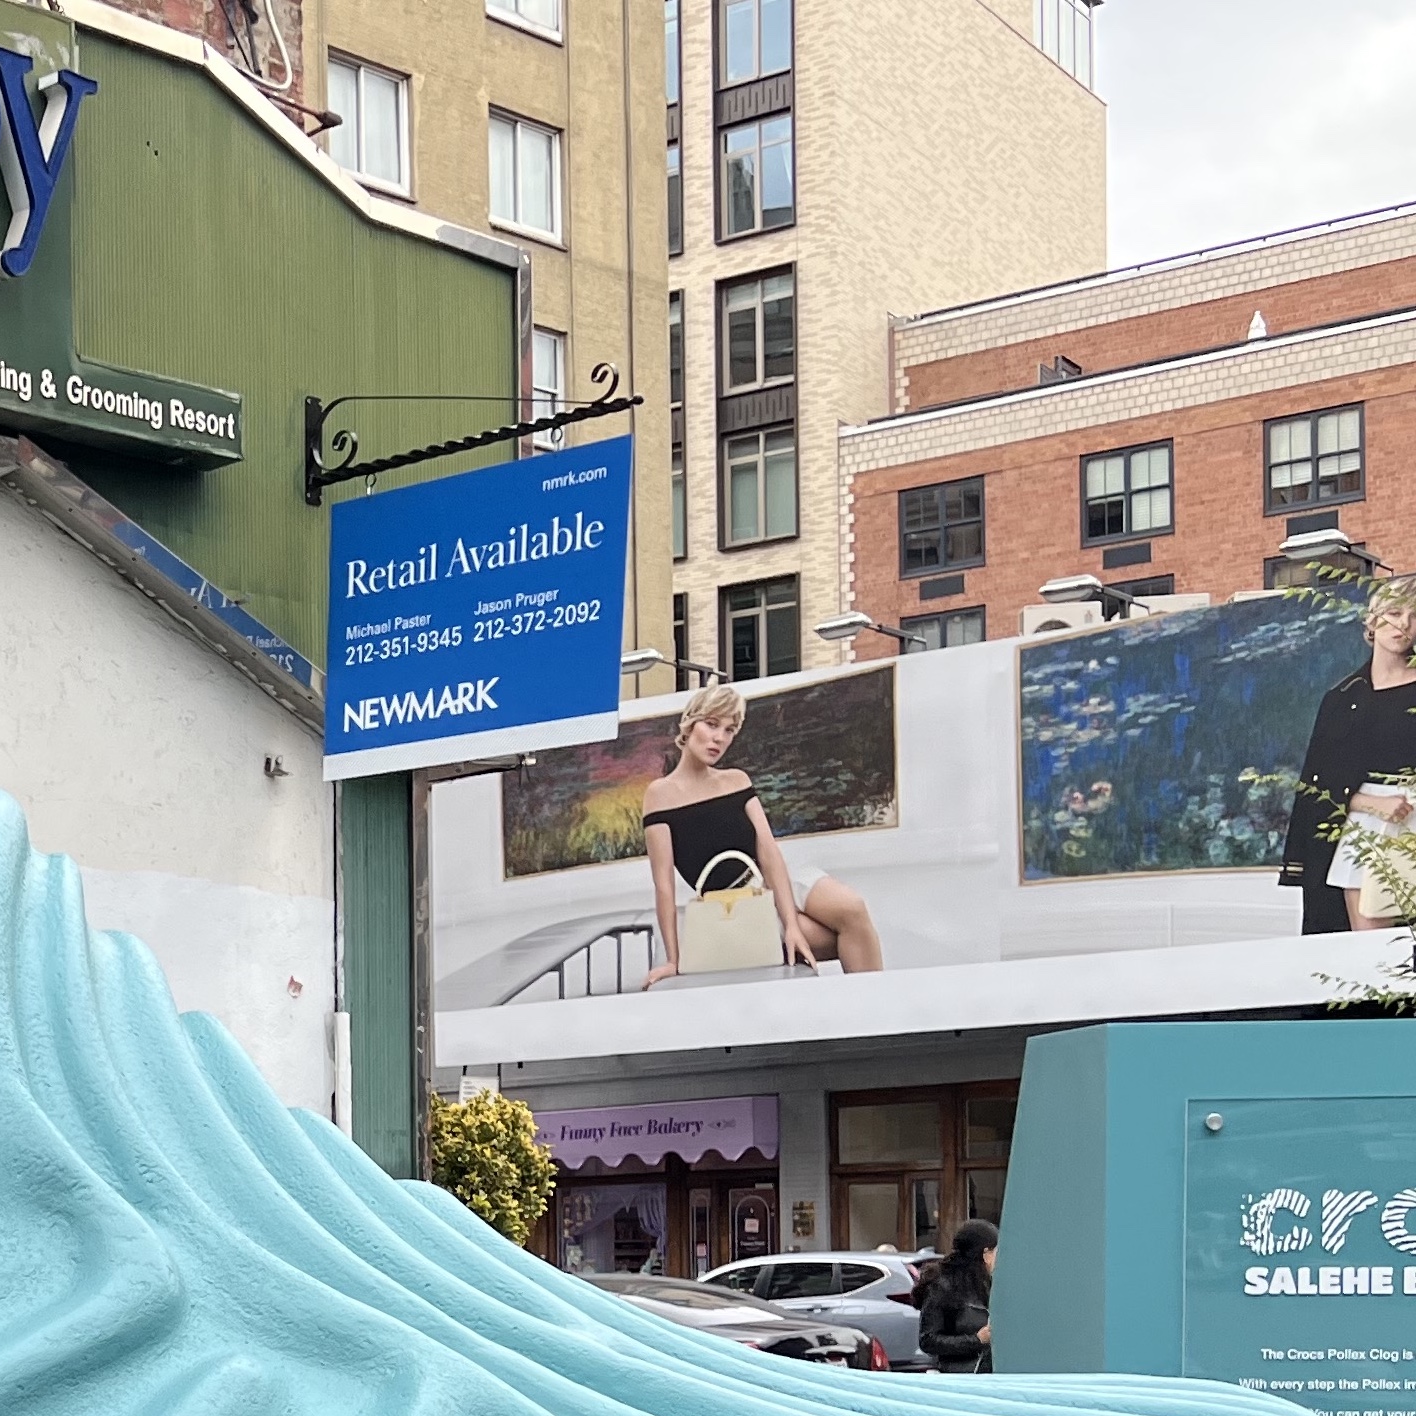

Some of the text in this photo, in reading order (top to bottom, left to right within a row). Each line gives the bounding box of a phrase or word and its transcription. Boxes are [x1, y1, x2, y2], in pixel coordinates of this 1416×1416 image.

[40, 369, 57, 399] &
[67, 375, 164, 429] Grooming
[169, 396, 236, 439] Resort
[541, 464, 608, 493] nmrk.com
[345, 512, 605, 600] Retail Available
[473, 588, 560, 617] Jason Pruger
[345, 612, 432, 642] Michael Paster
[473, 600, 601, 644] 212-372-2092
[345, 626, 463, 667] 212-351-9345
[343, 677, 501, 733] NEWMARK
[560, 1117, 704, 1144] Funny Face Bakery
[1244, 1266, 1393, 1295] SALEHE
[1261, 1348, 1413, 1362] The Crocs Pollex Clog is
[1239, 1377, 1267, 1390] With
[1270, 1379, 1304, 1392] every
[1307, 1379, 1335, 1391] step
[1338, 1378, 1358, 1390] the
[1362, 1378, 1400, 1390] Pollex
